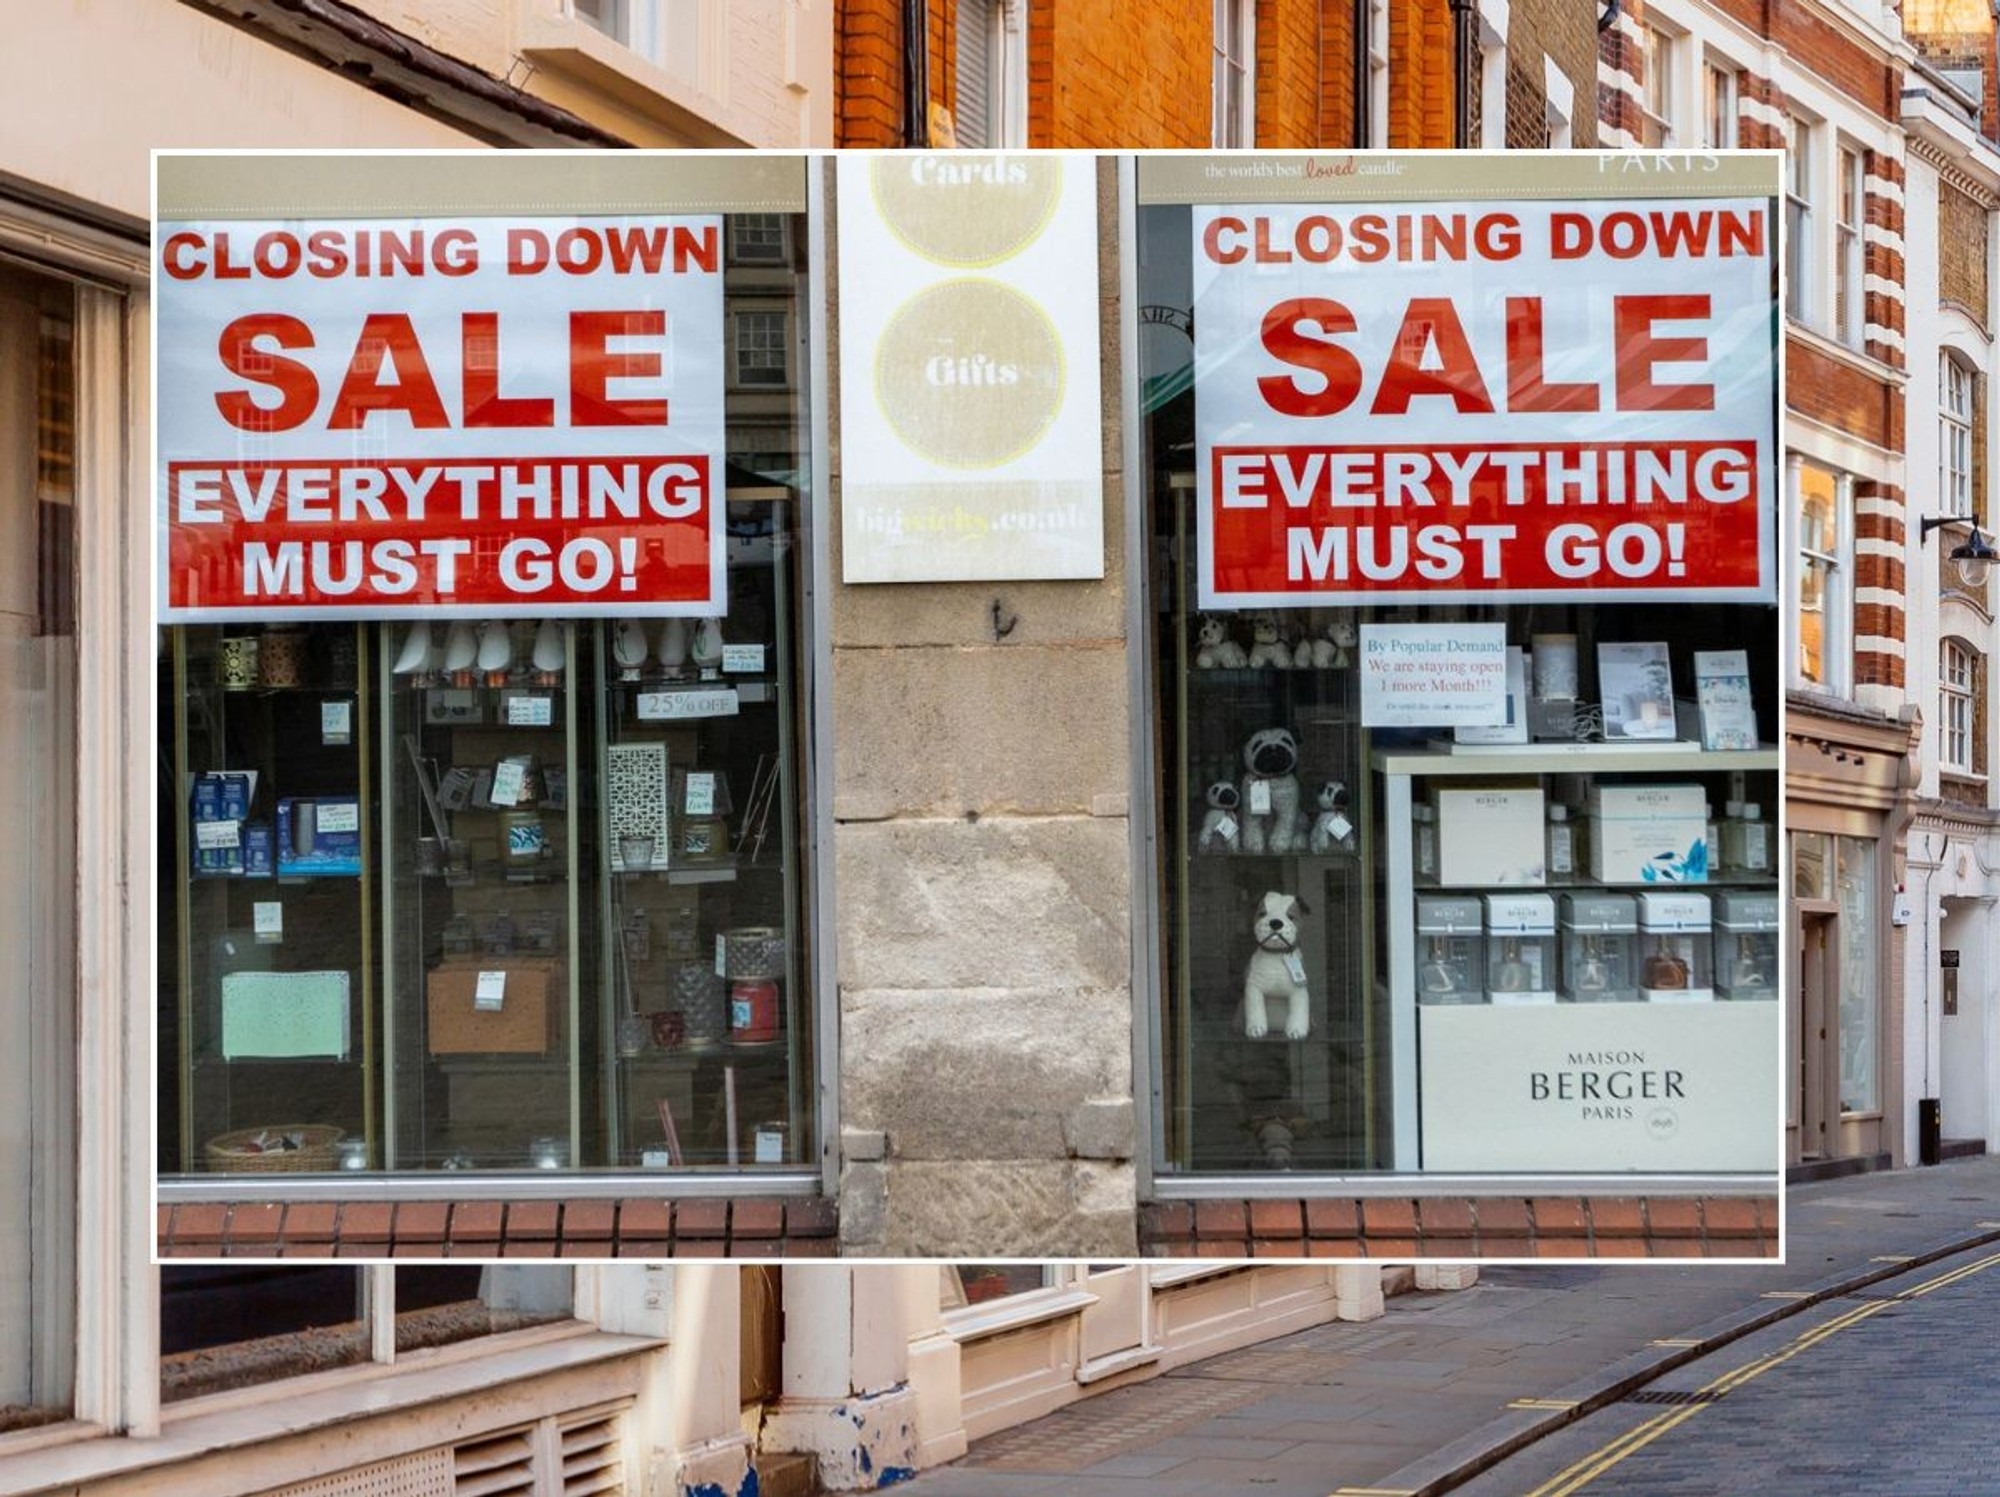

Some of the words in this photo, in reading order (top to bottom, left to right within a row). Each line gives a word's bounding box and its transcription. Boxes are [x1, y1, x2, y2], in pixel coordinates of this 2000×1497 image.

[911, 155, 1028, 184] Cards
[1205, 163, 1226, 177] the
[1276, 162, 1301, 177] best
[1305, 155, 1356, 179] loved
[1359, 160, 1404, 175] candle
[1203, 213, 1522, 264] CLOSING
[1550, 210, 1763, 260] DOWN
[163, 230, 478, 280] CLOSING
[507, 226, 718, 276] DOWN
[214, 310, 669, 432] SALE
[926, 354, 1018, 386] Gifts
[1257, 294, 1716, 418] SALE
[178, 463, 702, 524] EVERYTHING
[1221, 448, 1751, 508] EVERYTHING
[243, 538, 471, 596] MUST
[498, 536, 638, 593] GO!
[1286, 524, 1517, 581] MUST
[1544, 522, 1687, 579] GO!
[1368, 640, 1386, 654] By
[1391, 639, 1441, 655] Popular
[1446, 639, 1503, 653] Demand
[1368, 659, 1391, 673] We
[1394, 662, 1415, 673] are
[1419, 661, 1465, 676] staying
[1470, 662, 1503, 675] open
[1391, 682, 1426, 692] more
[649, 695, 695, 713] 25%
[700, 698, 729, 712] OFF
[1567, 1051, 1645, 1065] MAISON
[1530, 1070, 1685, 1101] BERGER
[1582, 1106, 1634, 1120] PARIS
